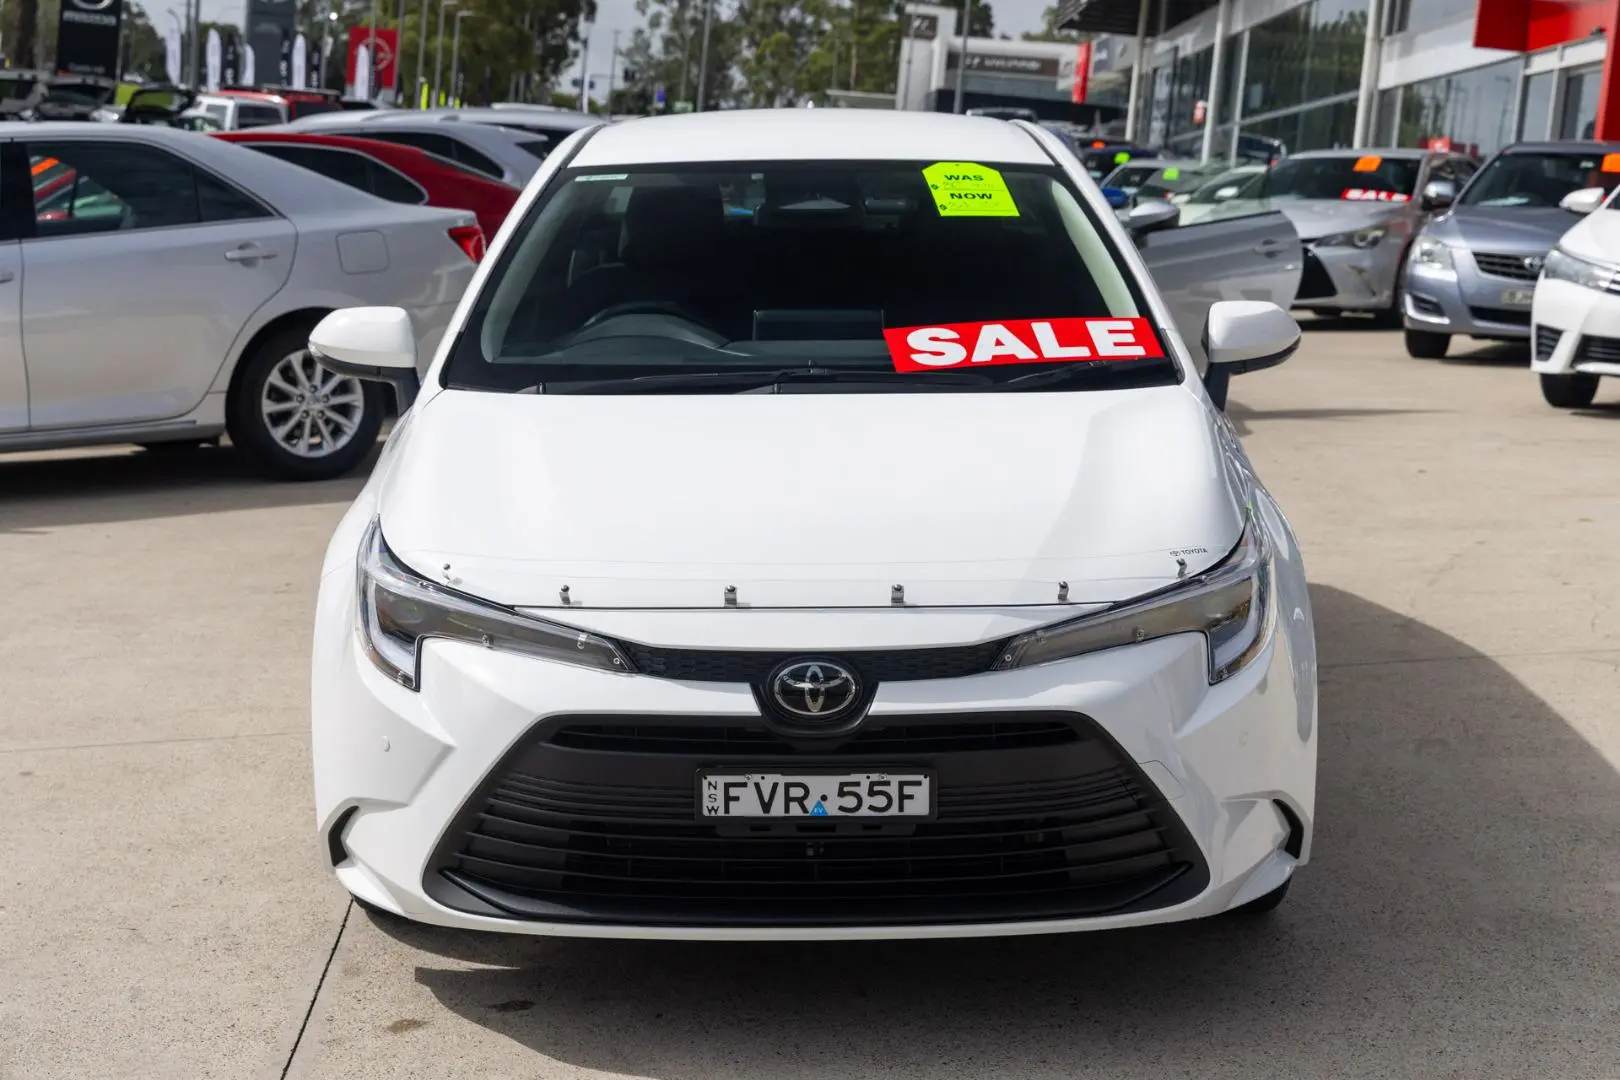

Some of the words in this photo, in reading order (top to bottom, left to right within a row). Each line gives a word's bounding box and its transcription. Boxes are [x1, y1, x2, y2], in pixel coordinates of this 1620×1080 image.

[949, 192, 993, 200] NOW
[1345, 188, 1408, 201] SALE
[906, 321, 1146, 366] SALE
[1180, 547, 1208, 555] TOYOTA
[706, 780, 720, 815] NSW
